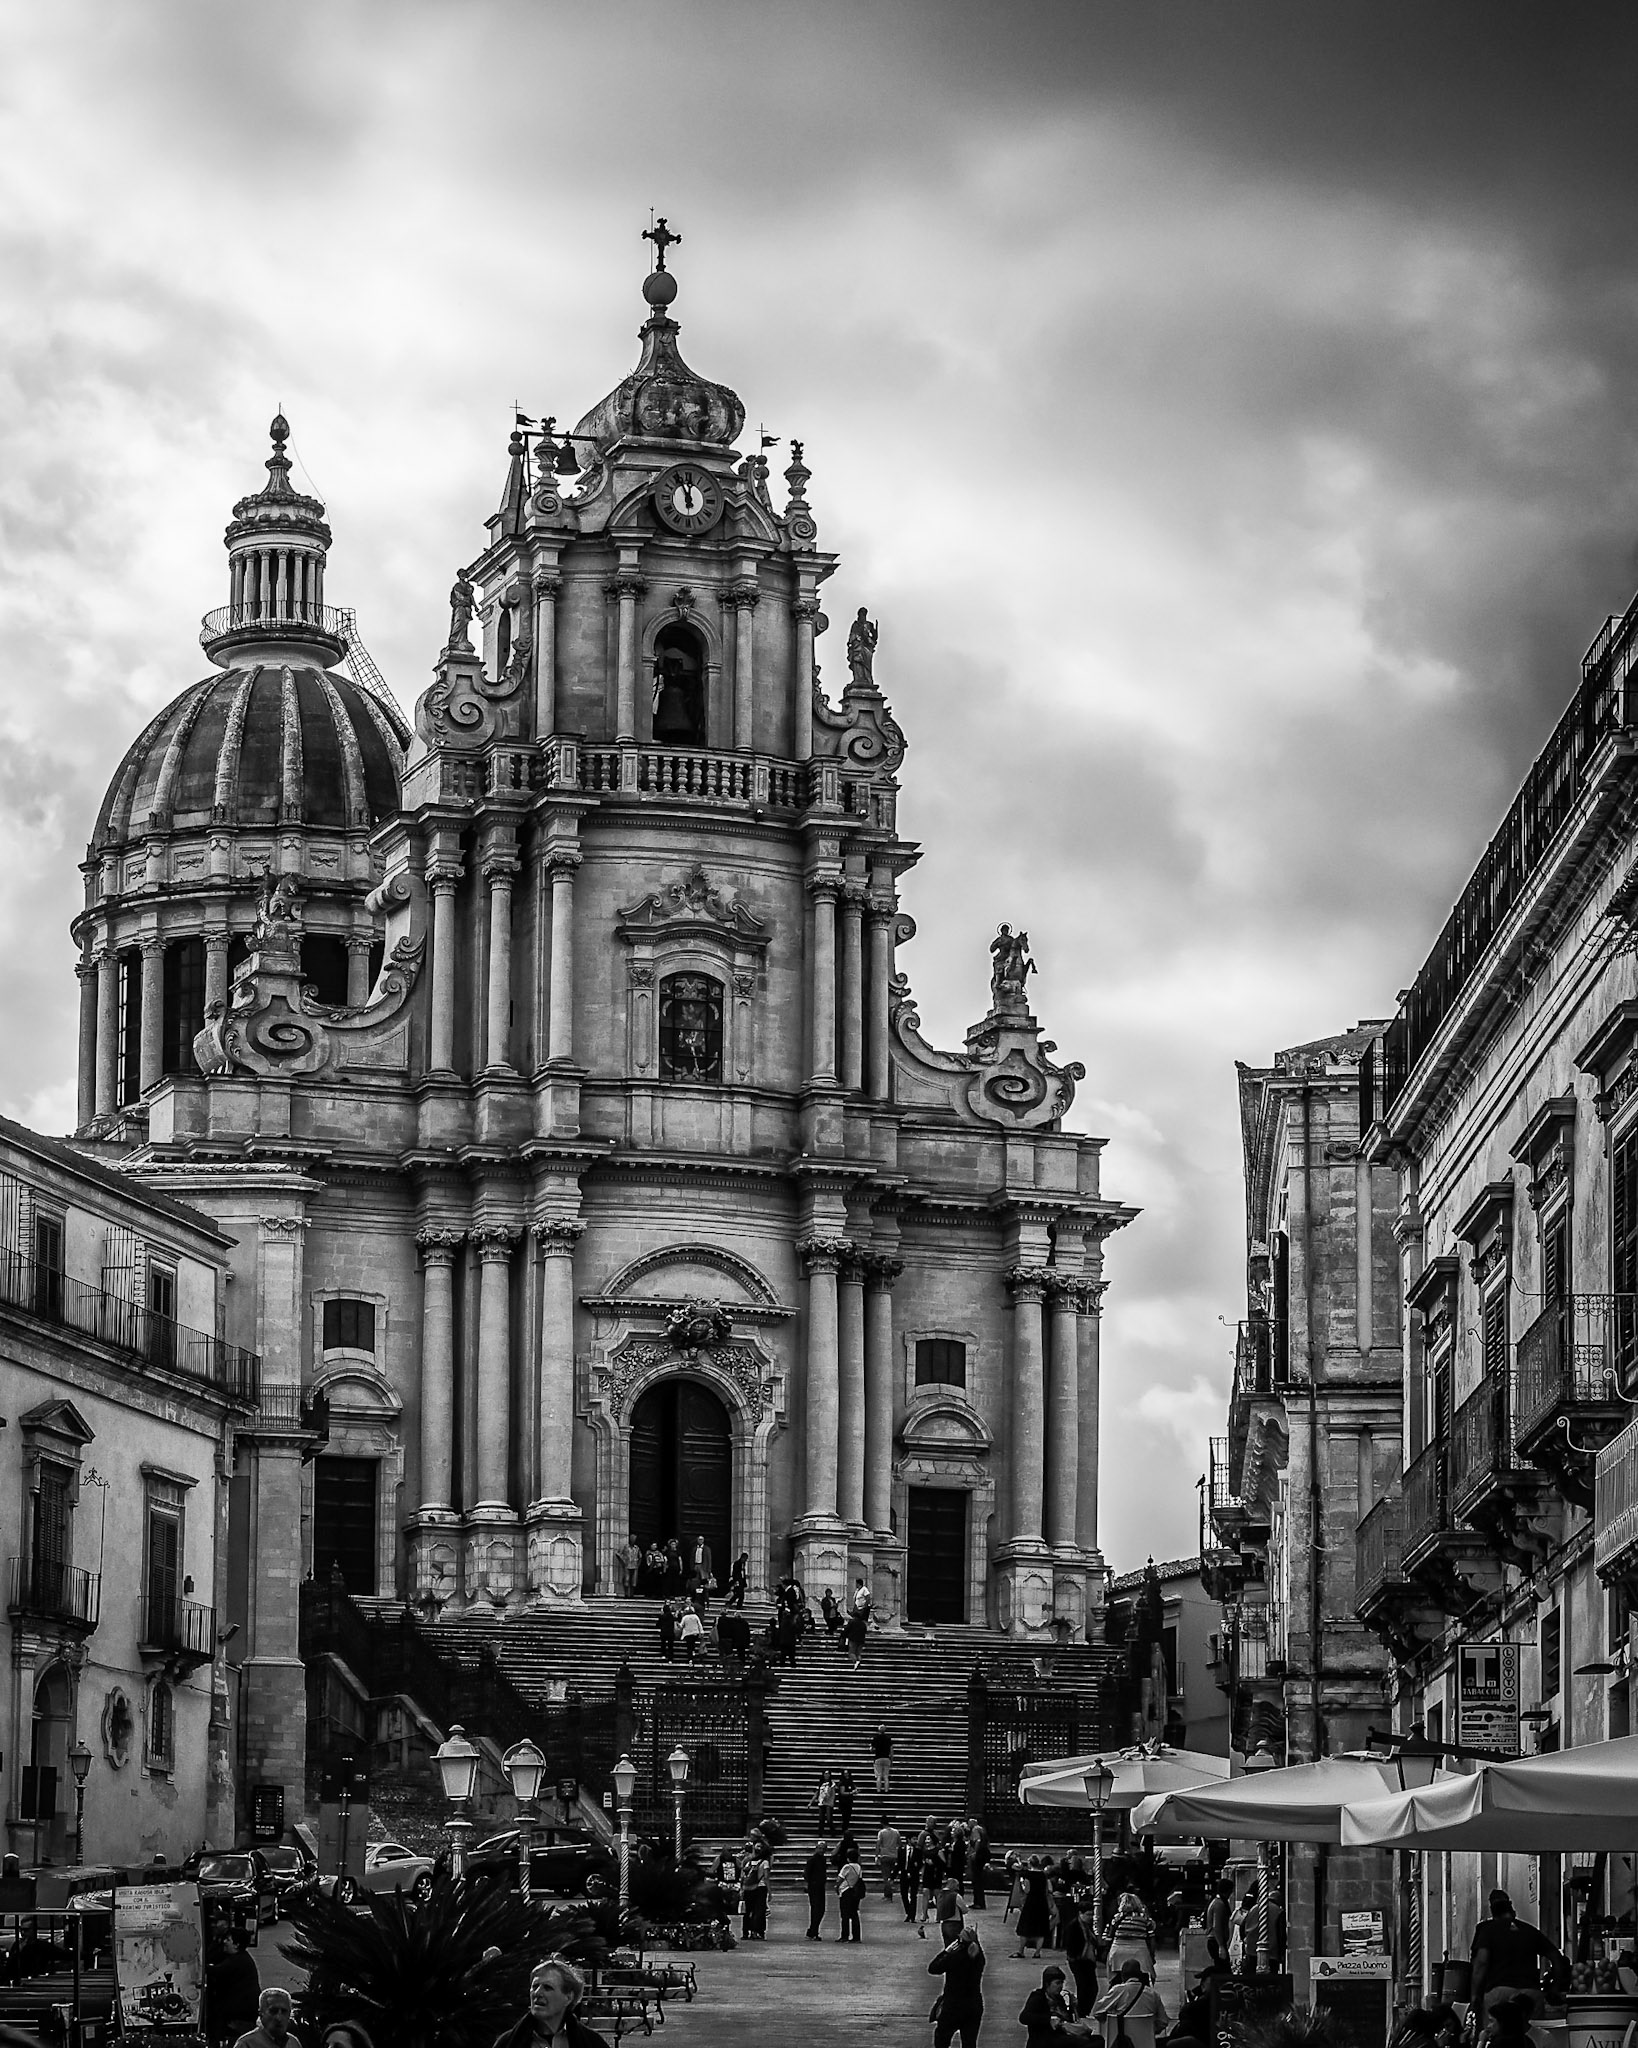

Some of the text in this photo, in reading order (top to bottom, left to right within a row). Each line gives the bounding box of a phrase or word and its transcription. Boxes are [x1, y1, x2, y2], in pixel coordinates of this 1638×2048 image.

[1465, 1648, 1496, 1687] T
[1503, 1647, 1515, 1698] LOTTO
[1337, 1960, 1388, 1969] Piazza Duomo
